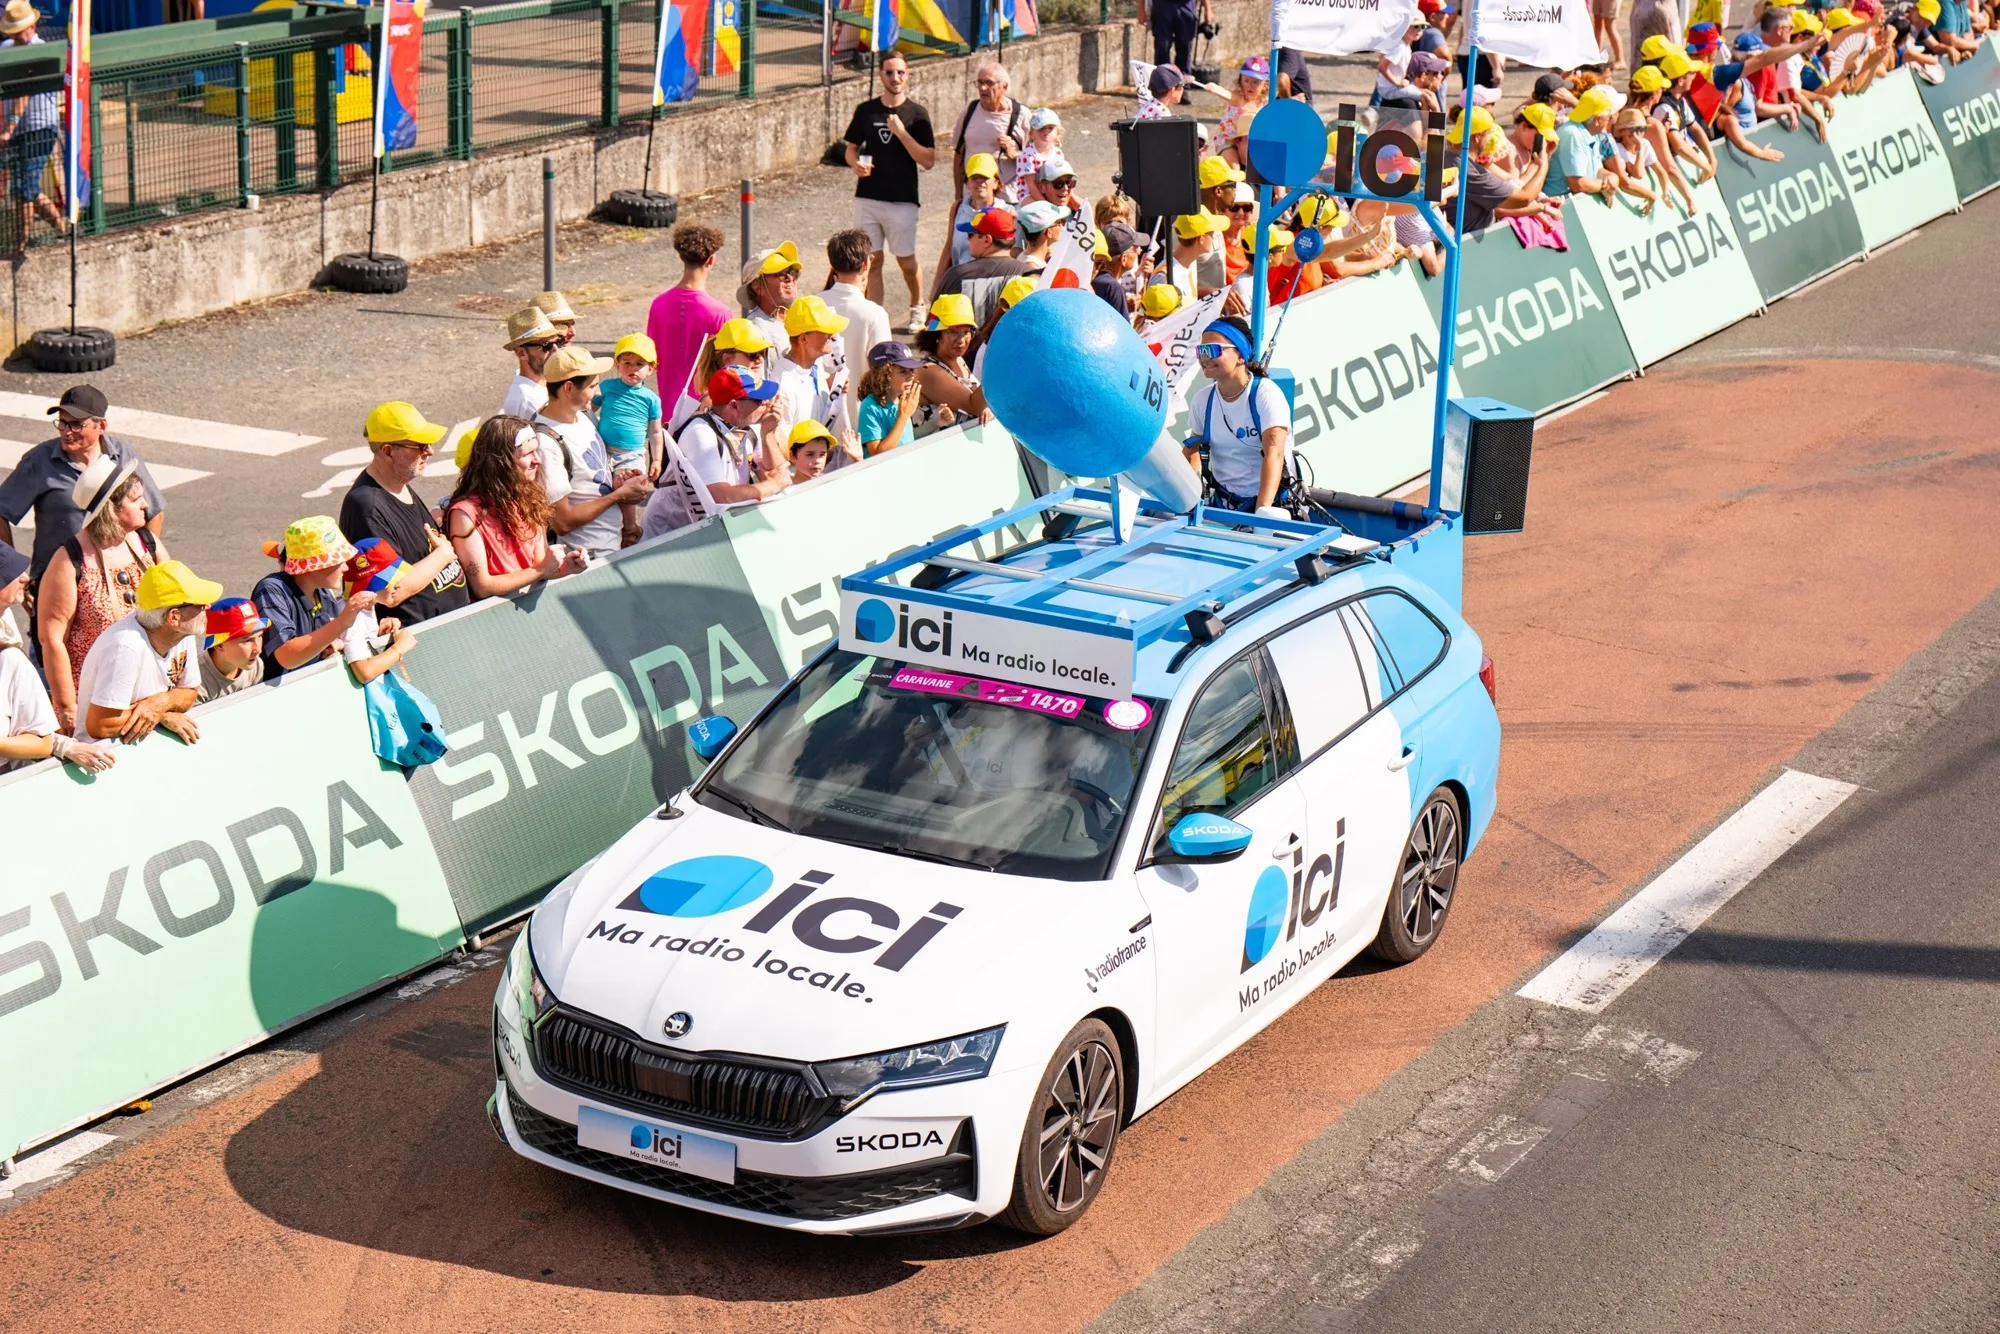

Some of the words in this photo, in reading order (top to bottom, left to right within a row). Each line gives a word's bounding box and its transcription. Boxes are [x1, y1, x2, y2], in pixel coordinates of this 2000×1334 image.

[1334, 103, 1446, 202] ici
[1143, 367, 1163, 412] ici
[1245, 426, 1258, 438] ic
[898, 603, 953, 657] ici
[962, 643, 991, 664] Ma
[996, 651, 1047, 674] radio
[1052, 658, 1117, 687] locale.
[895, 673, 955, 690] CARAVANE
[1030, 692, 1078, 714] 1470
[1286, 817, 1346, 943] ici
[742, 869, 966, 973] ici
[586, 920, 645, 945] Ma
[649, 933, 746, 962] radio
[752, 949, 874, 1004] locale.
[1096, 935, 1147, 980] radiofrance
[1238, 985, 1260, 1013] Ma
[1263, 957, 1297, 996] radio
[1298, 930, 1337, 970] locale.
[629, 1149, 641, 1159] Ma
[641, 1152, 658, 1164] radio
[659, 1157, 681, 1169] locale.
[653, 1128, 682, 1159] ici
